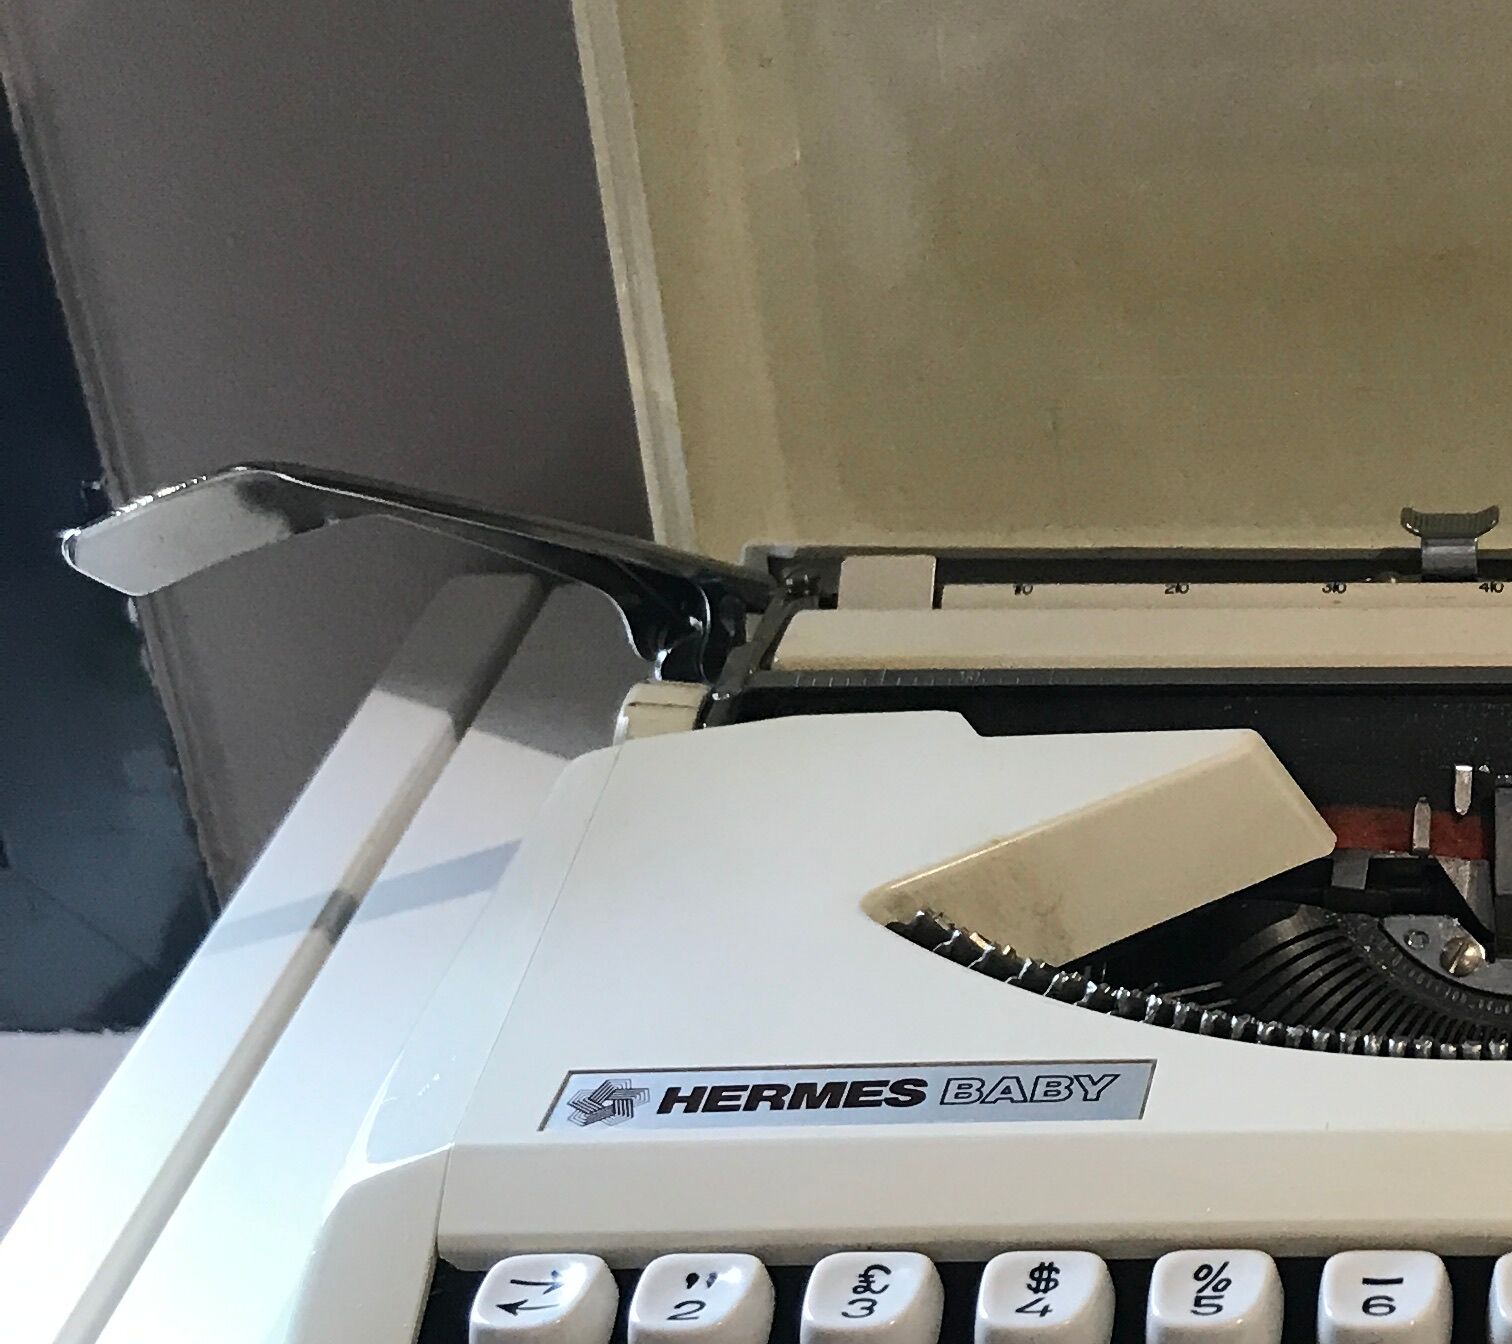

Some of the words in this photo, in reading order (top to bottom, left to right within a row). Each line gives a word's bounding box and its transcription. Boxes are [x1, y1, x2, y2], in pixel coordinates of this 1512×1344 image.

[656, 1078, 927, 1115] HERMES
[939, 1073, 1121, 1106] BABY
[851, 1263, 892, 1295] £
[1026, 1261, 1061, 1295] $
[1192, 1261, 1232, 1295] %
[666, 1299, 707, 1321] 2
[841, 1297, 878, 1319] 3
[1014, 1296, 1053, 1318] 4
[1191, 1294, 1225, 1316] 5
[1361, 1295, 1397, 1317] 6
